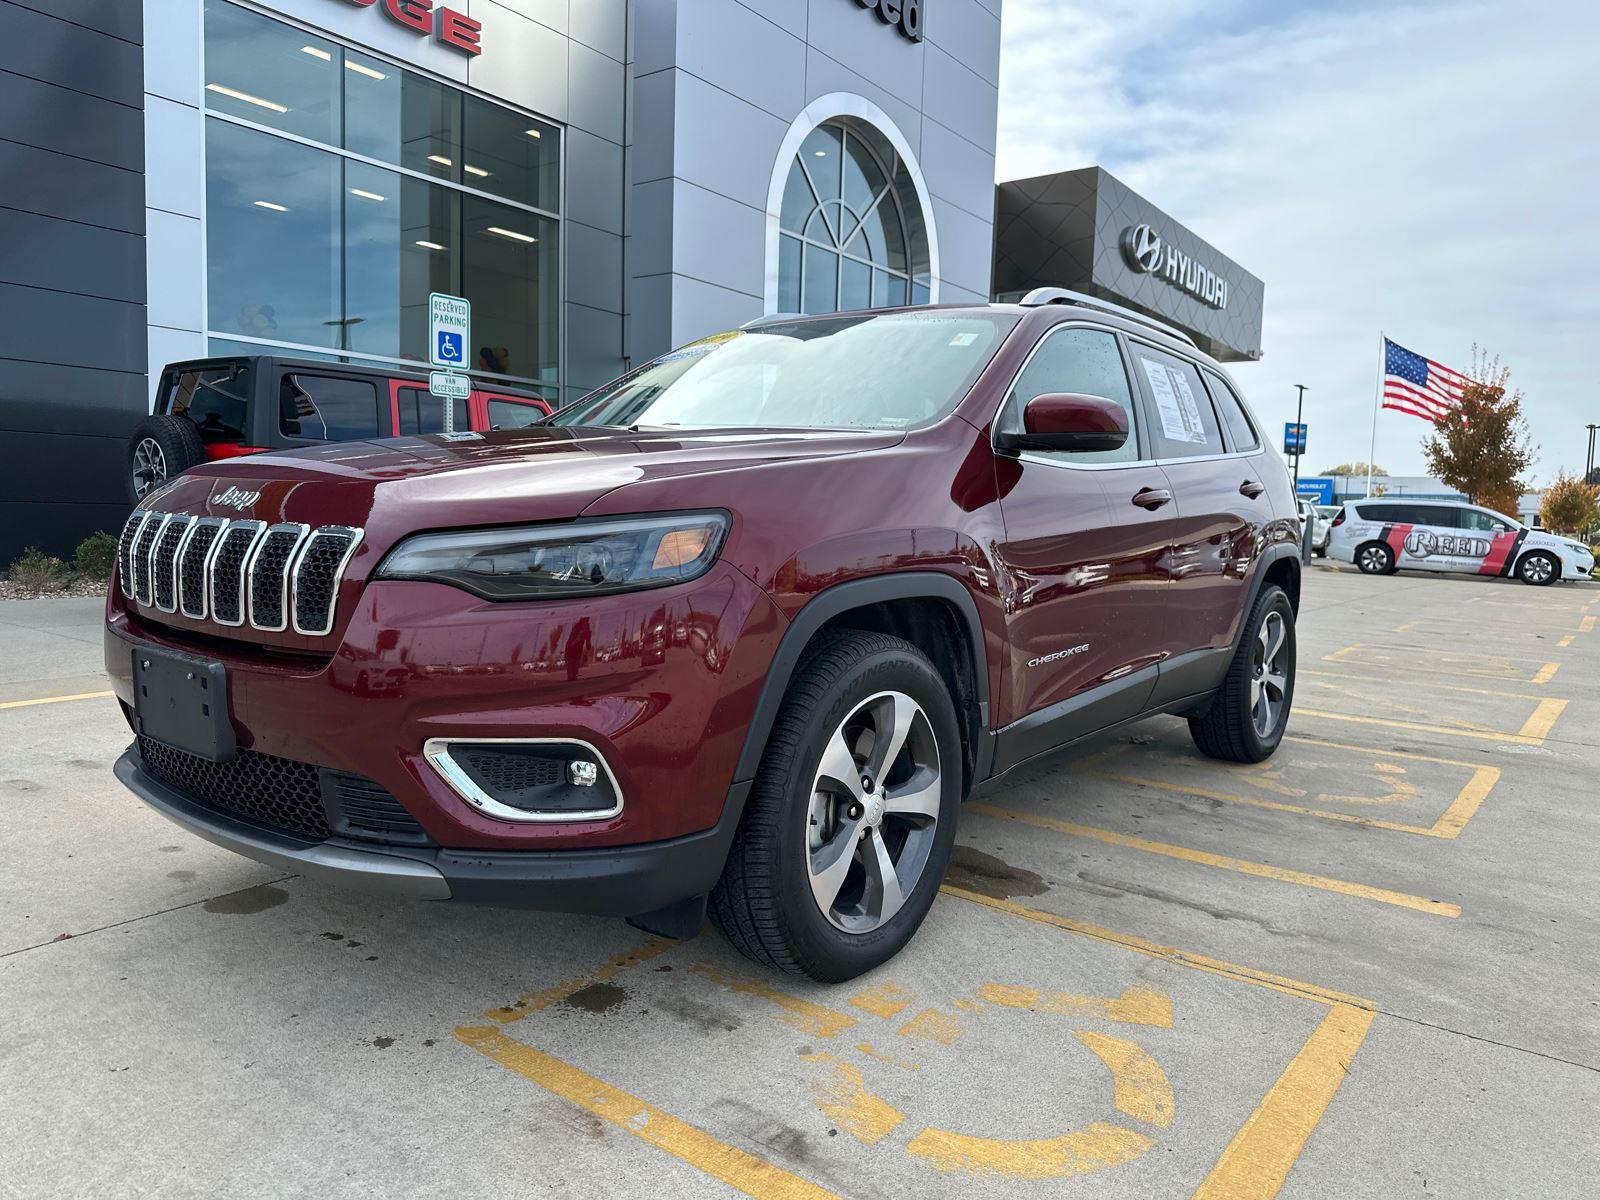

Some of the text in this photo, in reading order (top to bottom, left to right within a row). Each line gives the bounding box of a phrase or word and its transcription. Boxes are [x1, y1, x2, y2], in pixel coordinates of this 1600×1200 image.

[344, 0, 482, 58] GE
[1164, 244, 1228, 310] HYUNDAI
[434, 300, 467, 316] RESERVED
[434, 313, 467, 328] PARKING
[433, 384, 467, 395] ACCESSIBLE
[444, 377, 456, 385] VAN
[211, 485, 262, 511] Jeep
[1403, 529, 1491, 558] REED
[1027, 643, 1090, 667] CHEROKEE
